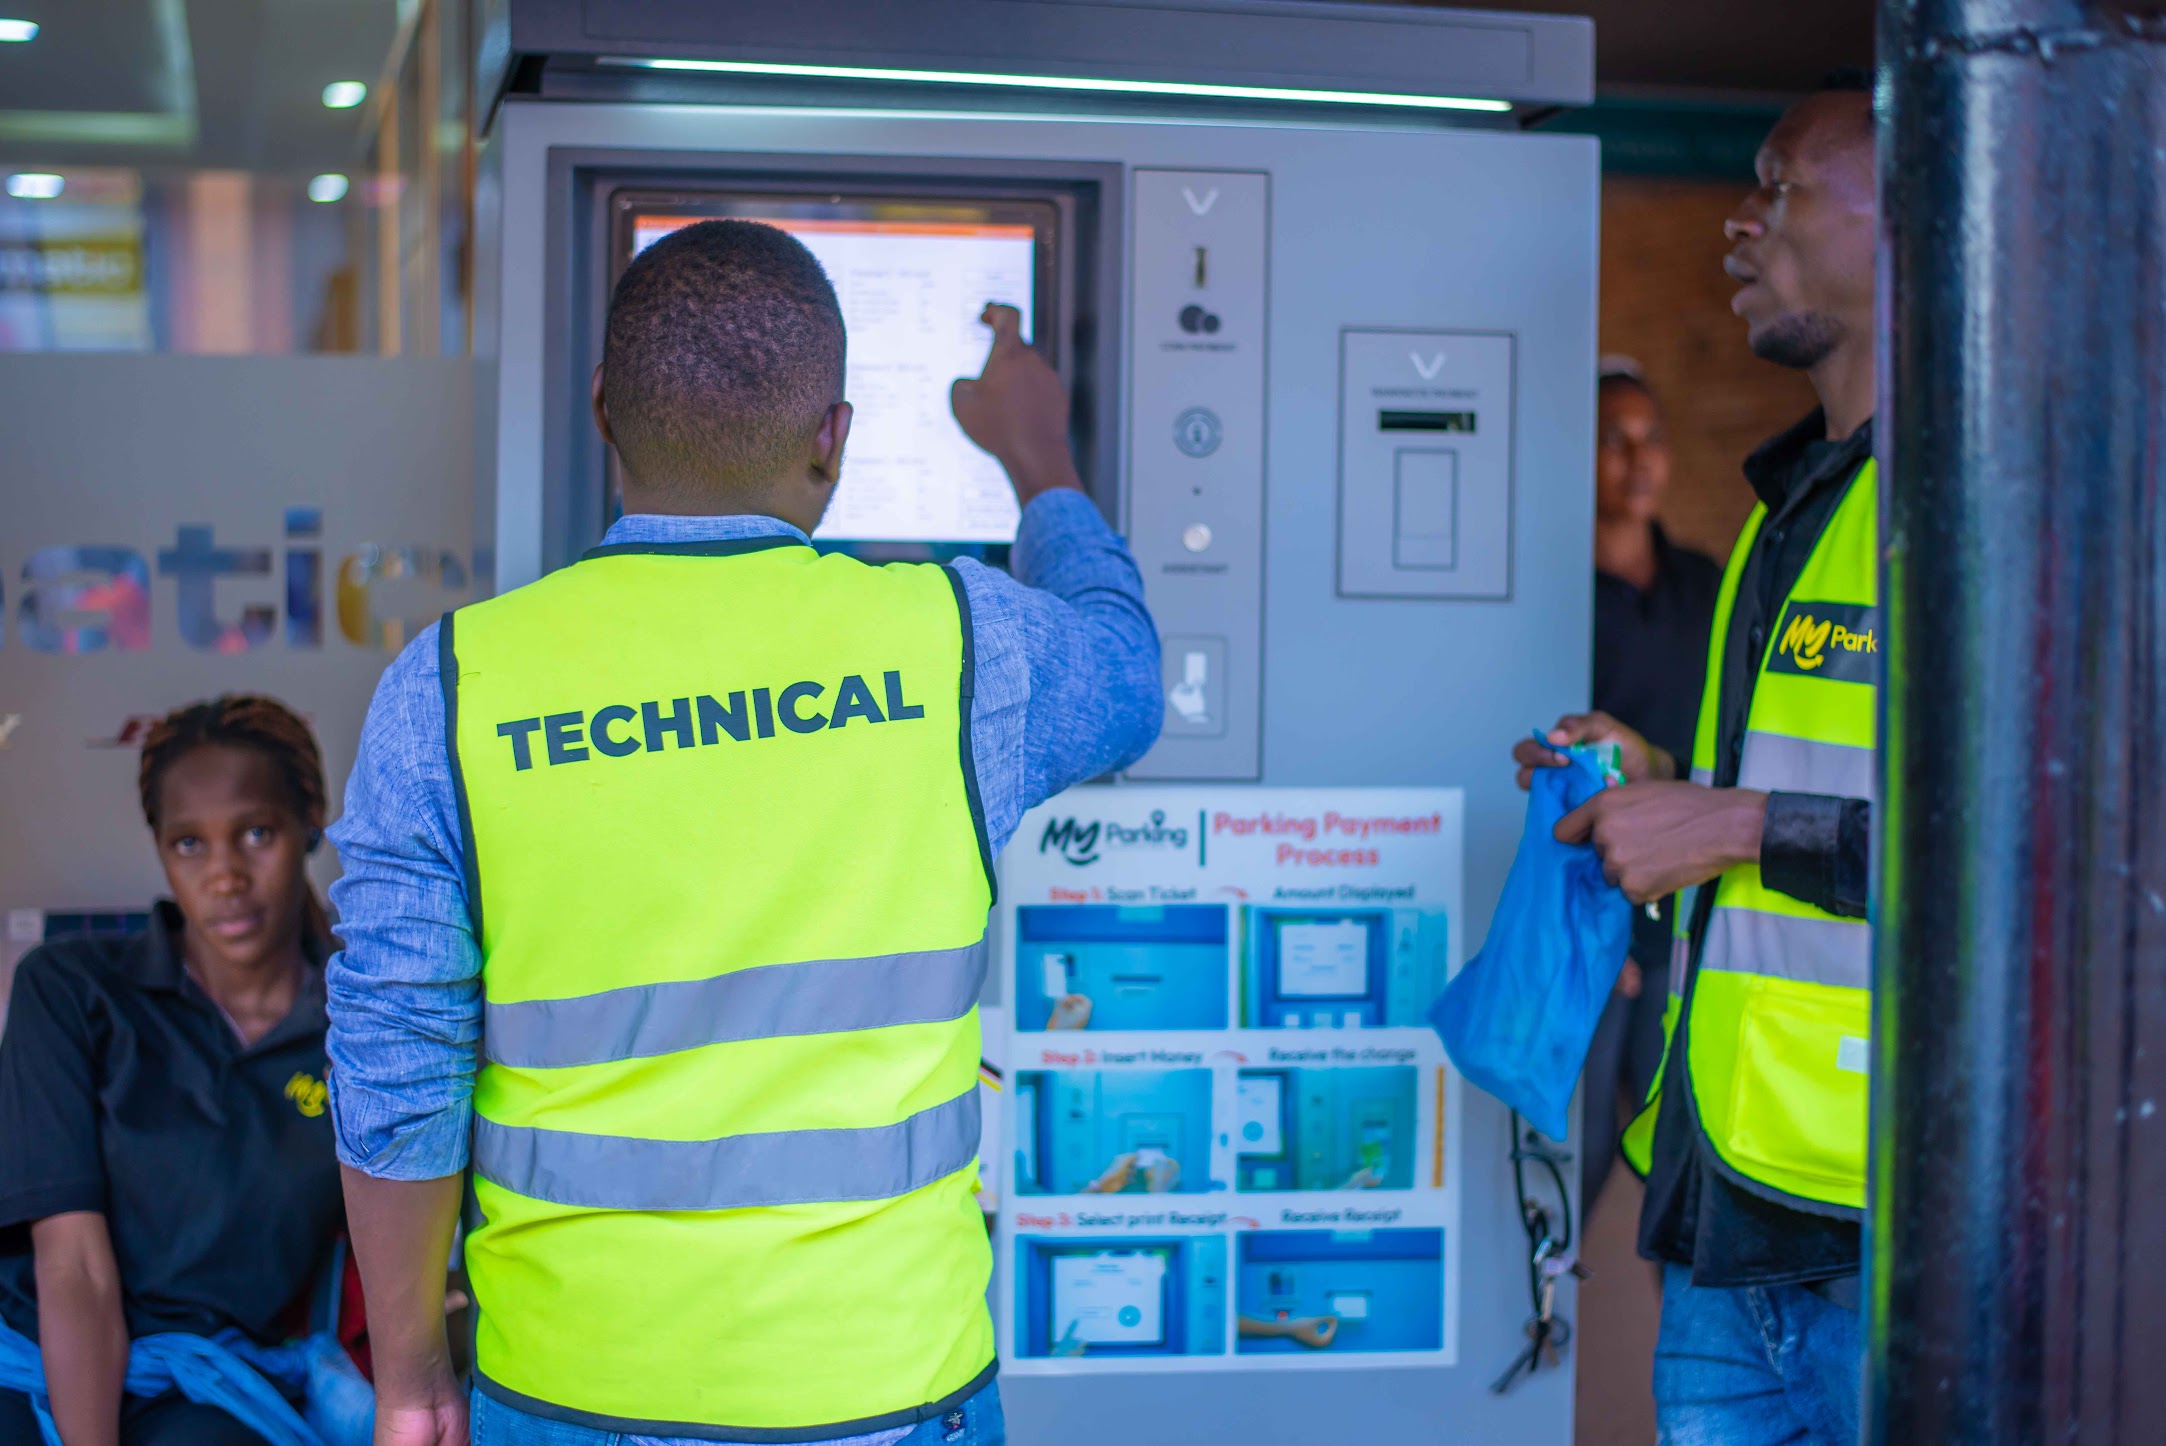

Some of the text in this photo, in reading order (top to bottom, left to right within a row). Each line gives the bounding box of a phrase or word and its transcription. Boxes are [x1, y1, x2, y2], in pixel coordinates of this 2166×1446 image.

[1779, 614, 1832, 670] My
[496, 670, 926, 772] TECHNICAL
[1214, 811, 1442, 841] Parking Payment
[1040, 809, 1188, 866] My Parking
[1277, 843, 1380, 866] Process
[1049, 886, 1088, 904] Step
[1107, 887, 1146, 901] Scan
[1150, 885, 1197, 901] Ticket
[1273, 884, 1416, 902] Amount Displayed
[1102, 1050, 1147, 1064] Insert
[1151, 1050, 1203, 1066] Money
[1269, 1045, 1416, 1062] Receive the change
[1077, 1211, 1124, 1226] Select
[1127, 1212, 1165, 1229] print
[1169, 1209, 1228, 1228] Receipt
[1281, 1206, 1403, 1225] Receive Receipt
